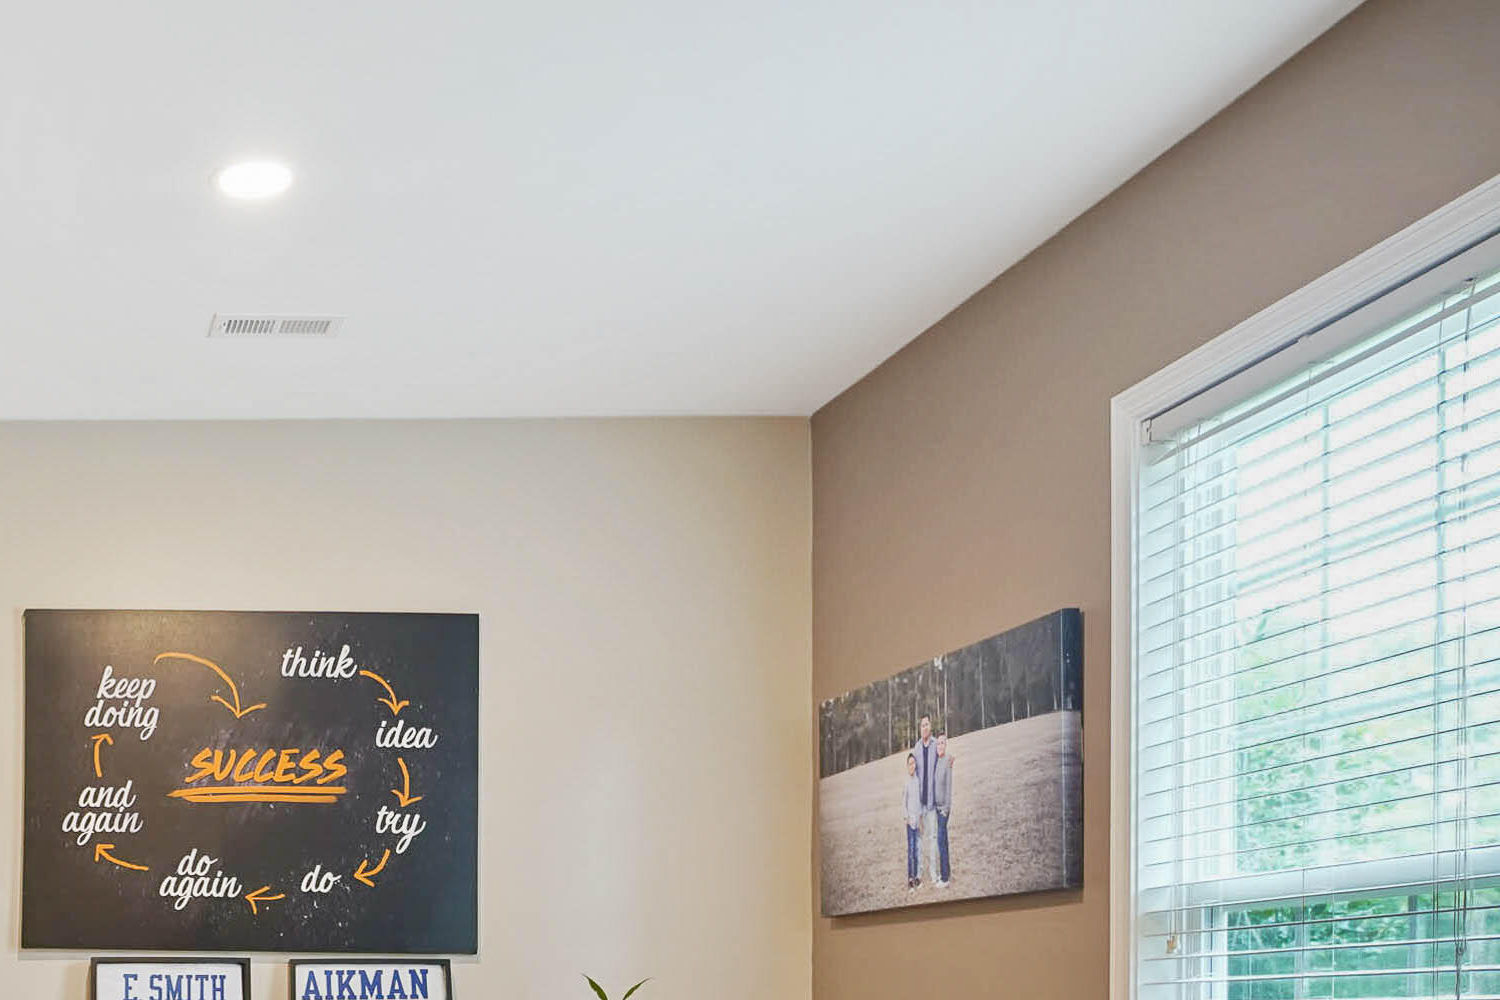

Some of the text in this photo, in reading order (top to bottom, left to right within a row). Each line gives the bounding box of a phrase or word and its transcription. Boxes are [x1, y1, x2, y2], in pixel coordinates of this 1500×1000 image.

[281, 644, 358, 678] think
[97, 665, 156, 707] keep
[84, 699, 160, 741] doing
[375, 719, 438, 749] idea
[184, 748, 348, 784] SUCCESS
[78, 780, 137, 808] and
[62, 806, 143, 846] again
[375, 805, 426, 854] try
[177, 848, 218, 876] do
[300, 864, 342, 893] do
[159, 870, 243, 911] again
[302, 968, 429, 1000] AIKMAN
